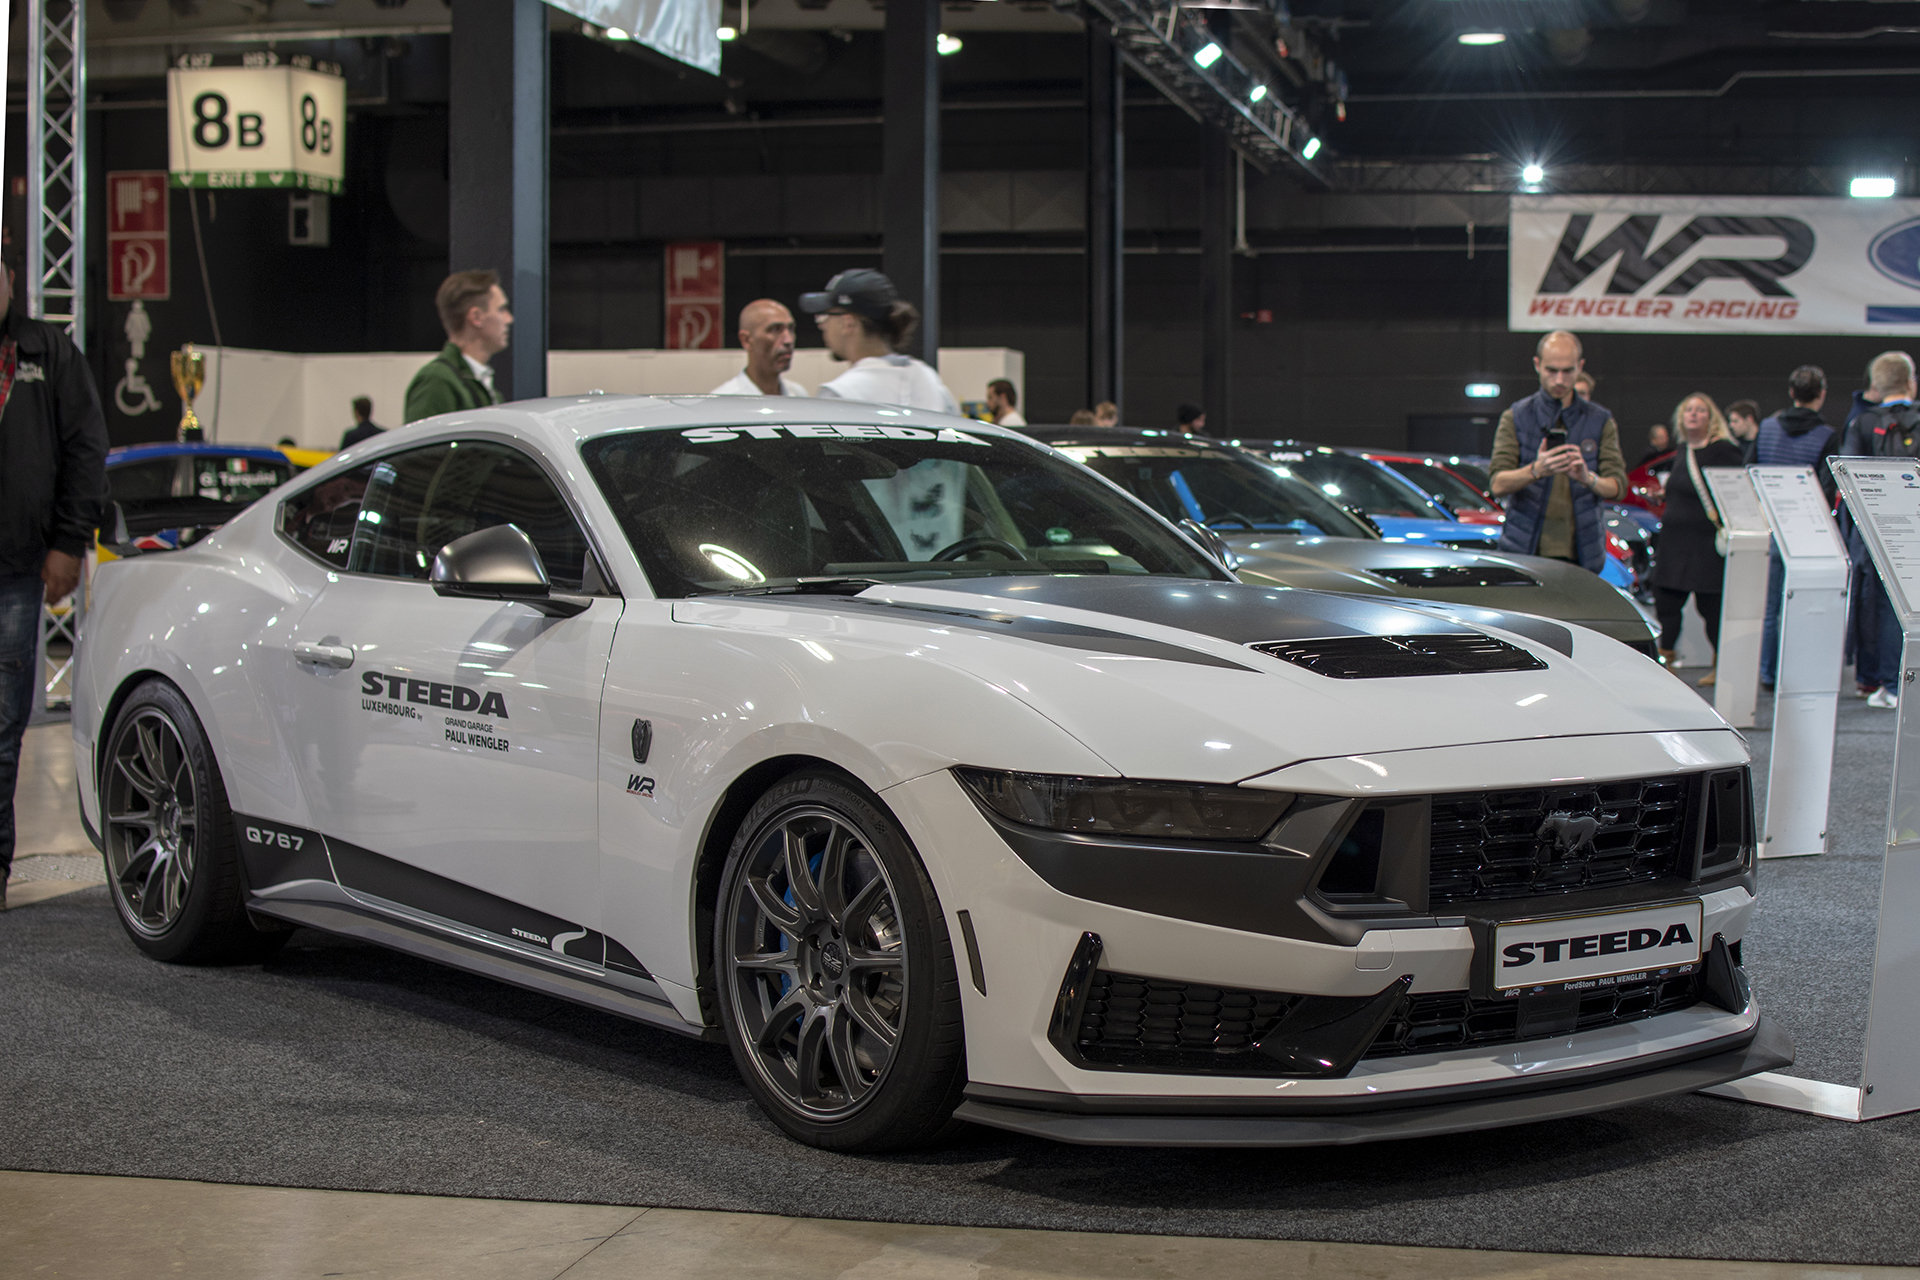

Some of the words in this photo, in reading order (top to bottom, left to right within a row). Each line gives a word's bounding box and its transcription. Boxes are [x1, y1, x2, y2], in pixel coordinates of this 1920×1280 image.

[192, 93, 264, 149] 8B
[301, 94, 332, 155] 8B
[1537, 213, 1817, 299] WR
[1528, 298, 1674, 318] WENGLER
[1683, 300, 1801, 320] RACING
[681, 424, 993, 446] STEEDA
[327, 538, 349, 553] WR
[361, 671, 509, 719] STEEDA
[361, 698, 416, 719] LUXEMBOURG
[417, 713, 423, 721] by
[445, 717, 467, 729] GRAND
[467, 721, 493, 733] GARAGE
[445, 729, 467, 745] PAUL
[468, 732, 510, 752] WENGLER
[627, 773, 655, 795] WR
[246, 826, 304, 851] Q767
[511, 927, 548, 945] STEEDA
[1502, 923, 1694, 968] STEEDA
[1678, 964, 1693, 973] WR
[1504, 988, 1521, 997] WR
[1563, 980, 1596, 991] FordStore
[1599, 976, 1616, 986] PAUL
[1616, 972, 1647, 983] WENGLER
